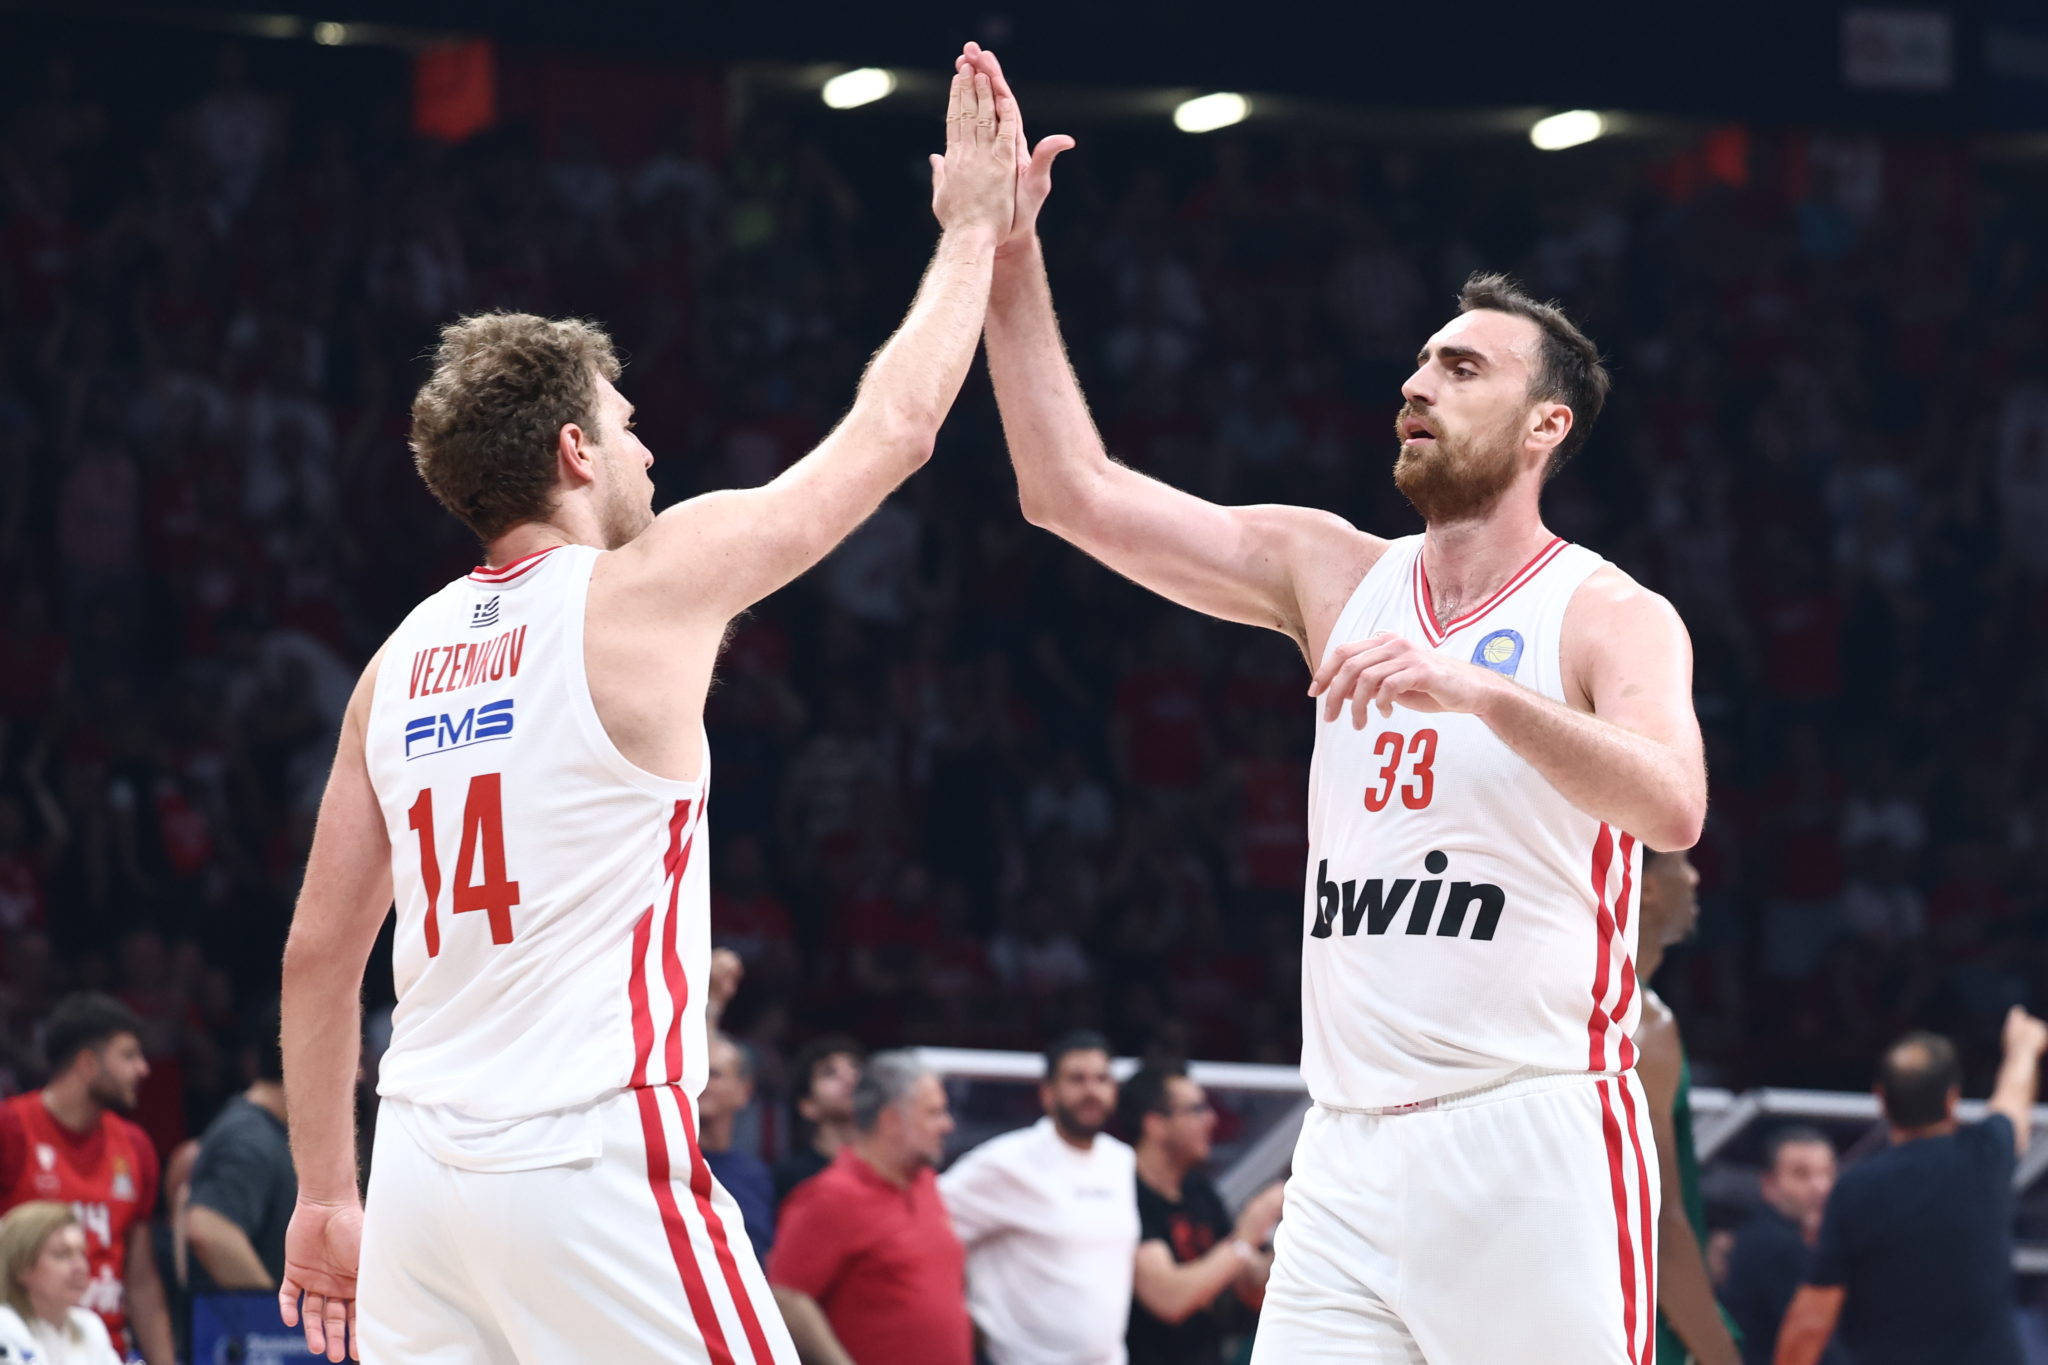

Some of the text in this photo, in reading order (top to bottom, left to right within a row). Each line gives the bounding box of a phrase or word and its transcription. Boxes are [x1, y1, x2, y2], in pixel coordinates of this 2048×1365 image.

[408, 624, 528, 700] VEZENKOV
[404, 698, 515, 758] FMS
[1364, 728, 1439, 813] 33
[407, 772, 521, 959] 14
[1309, 849, 1506, 942] bwin
